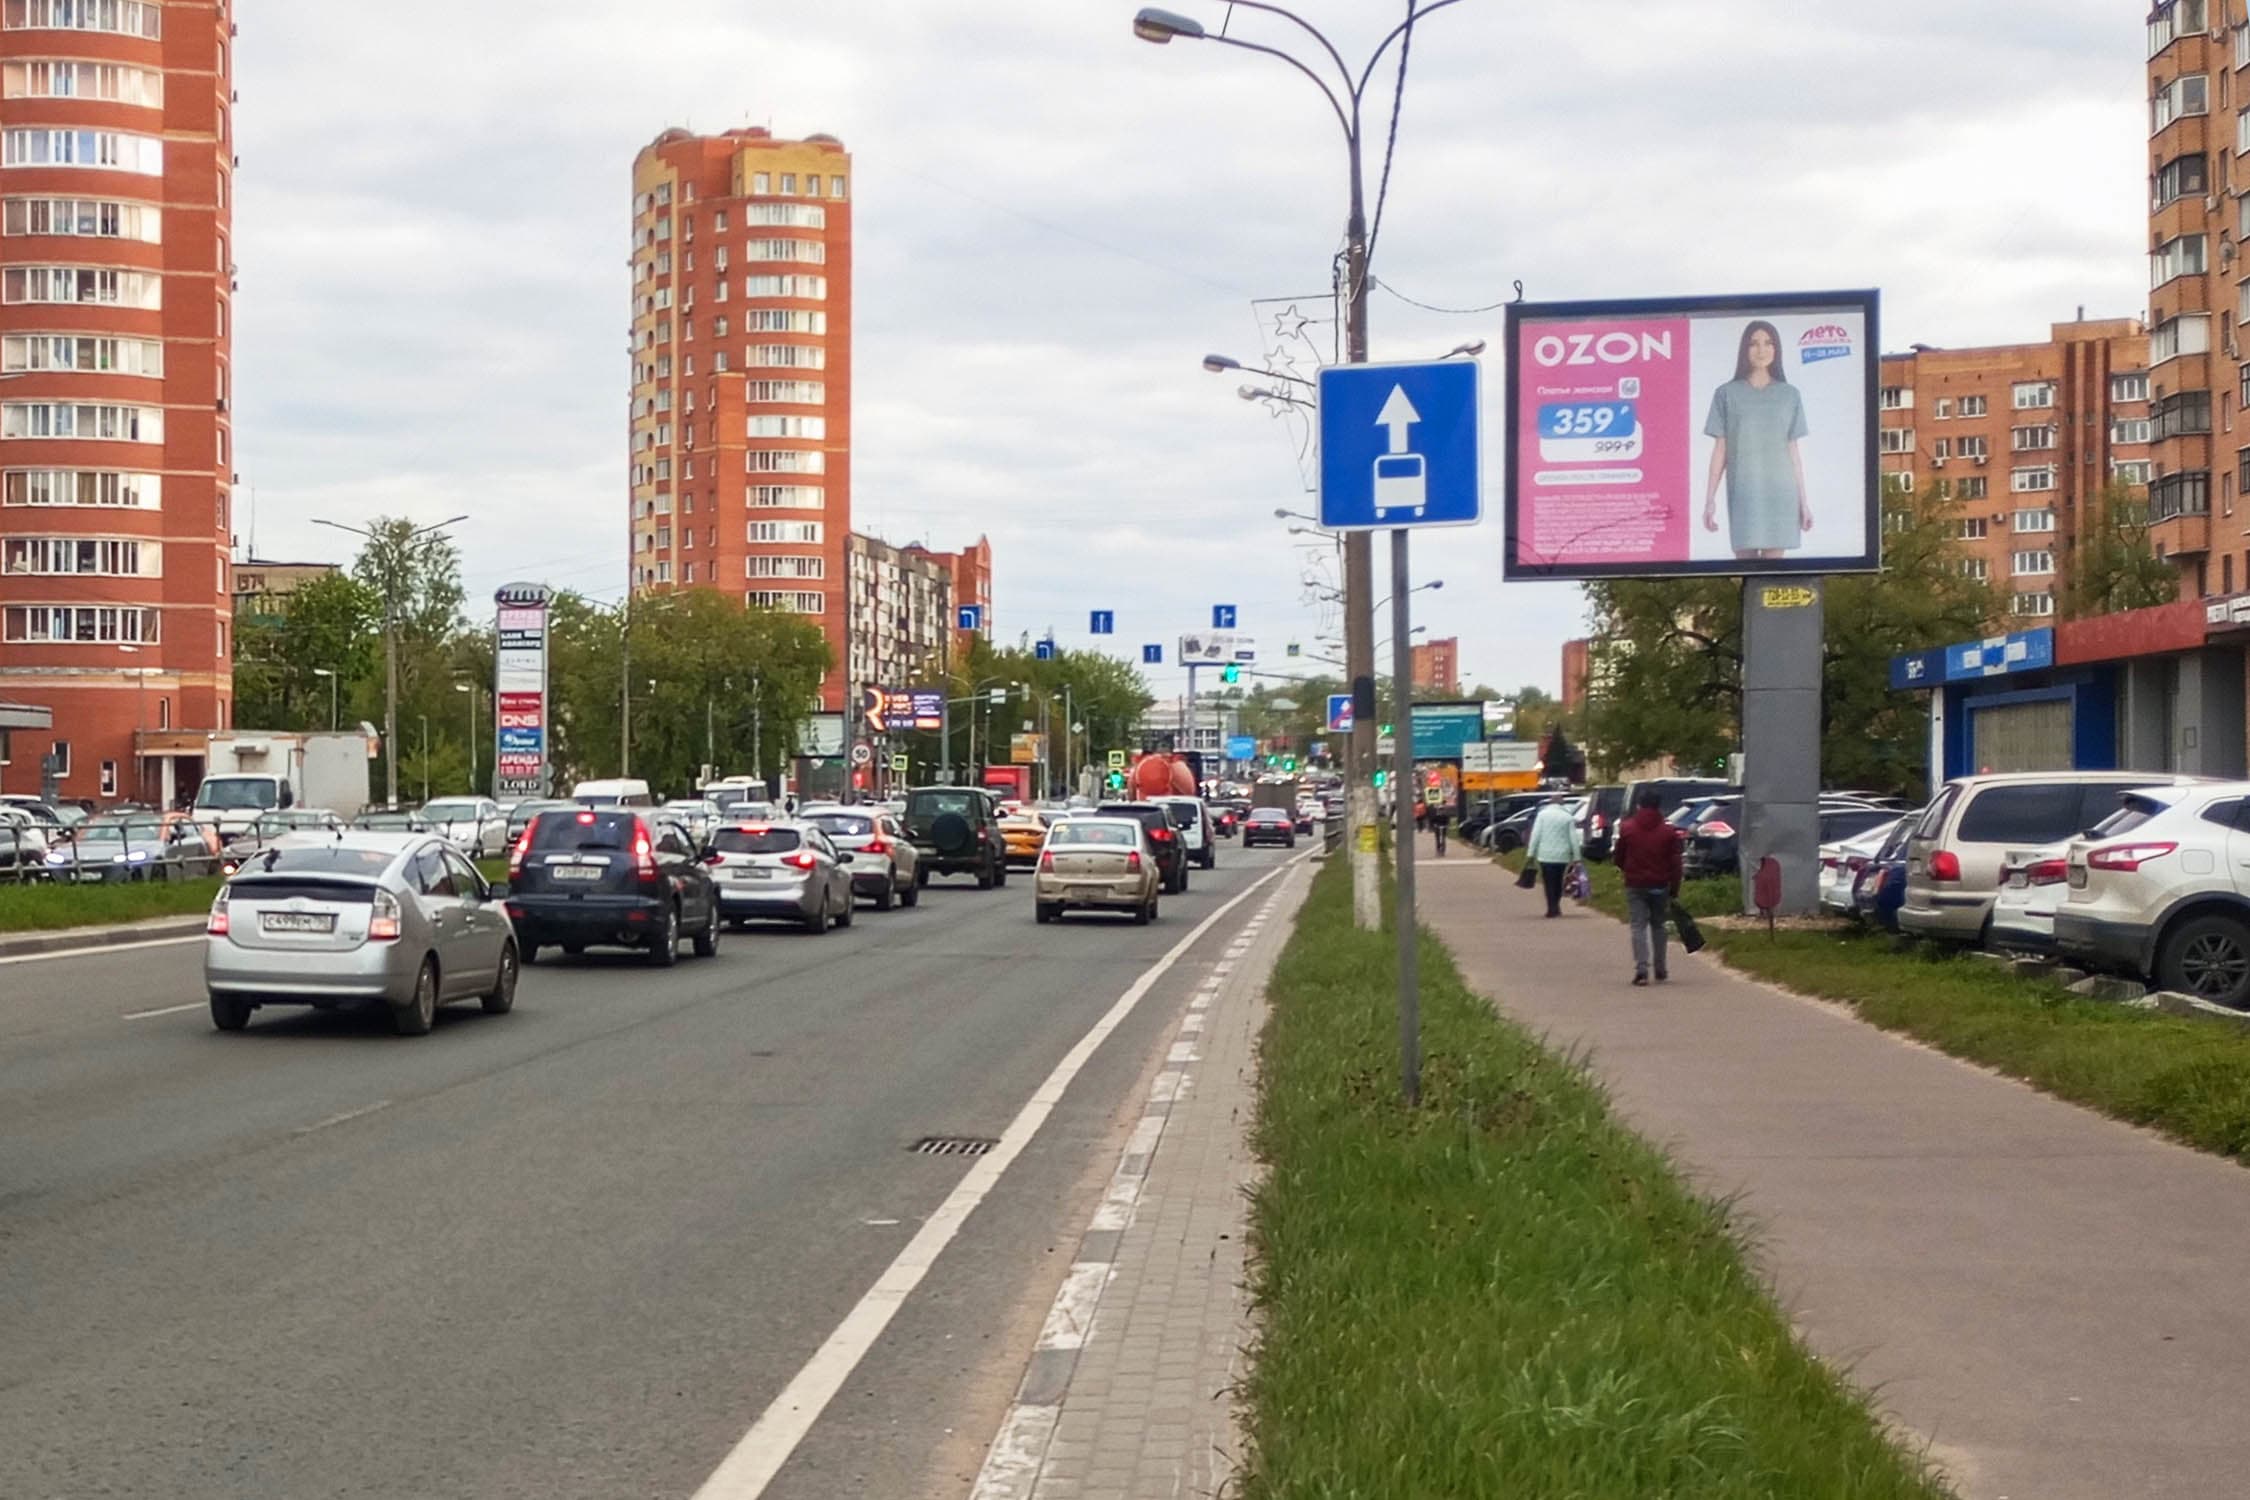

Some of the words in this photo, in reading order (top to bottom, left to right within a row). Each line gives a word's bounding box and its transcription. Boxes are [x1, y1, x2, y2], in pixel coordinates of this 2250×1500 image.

[1534, 330, 1672, 367] OZON
[1553, 407, 1614, 435] 359
[502, 714, 539, 727] DNS
[501, 755, 540, 765] АРЕНДА
[855, 750, 868, 759] 50
